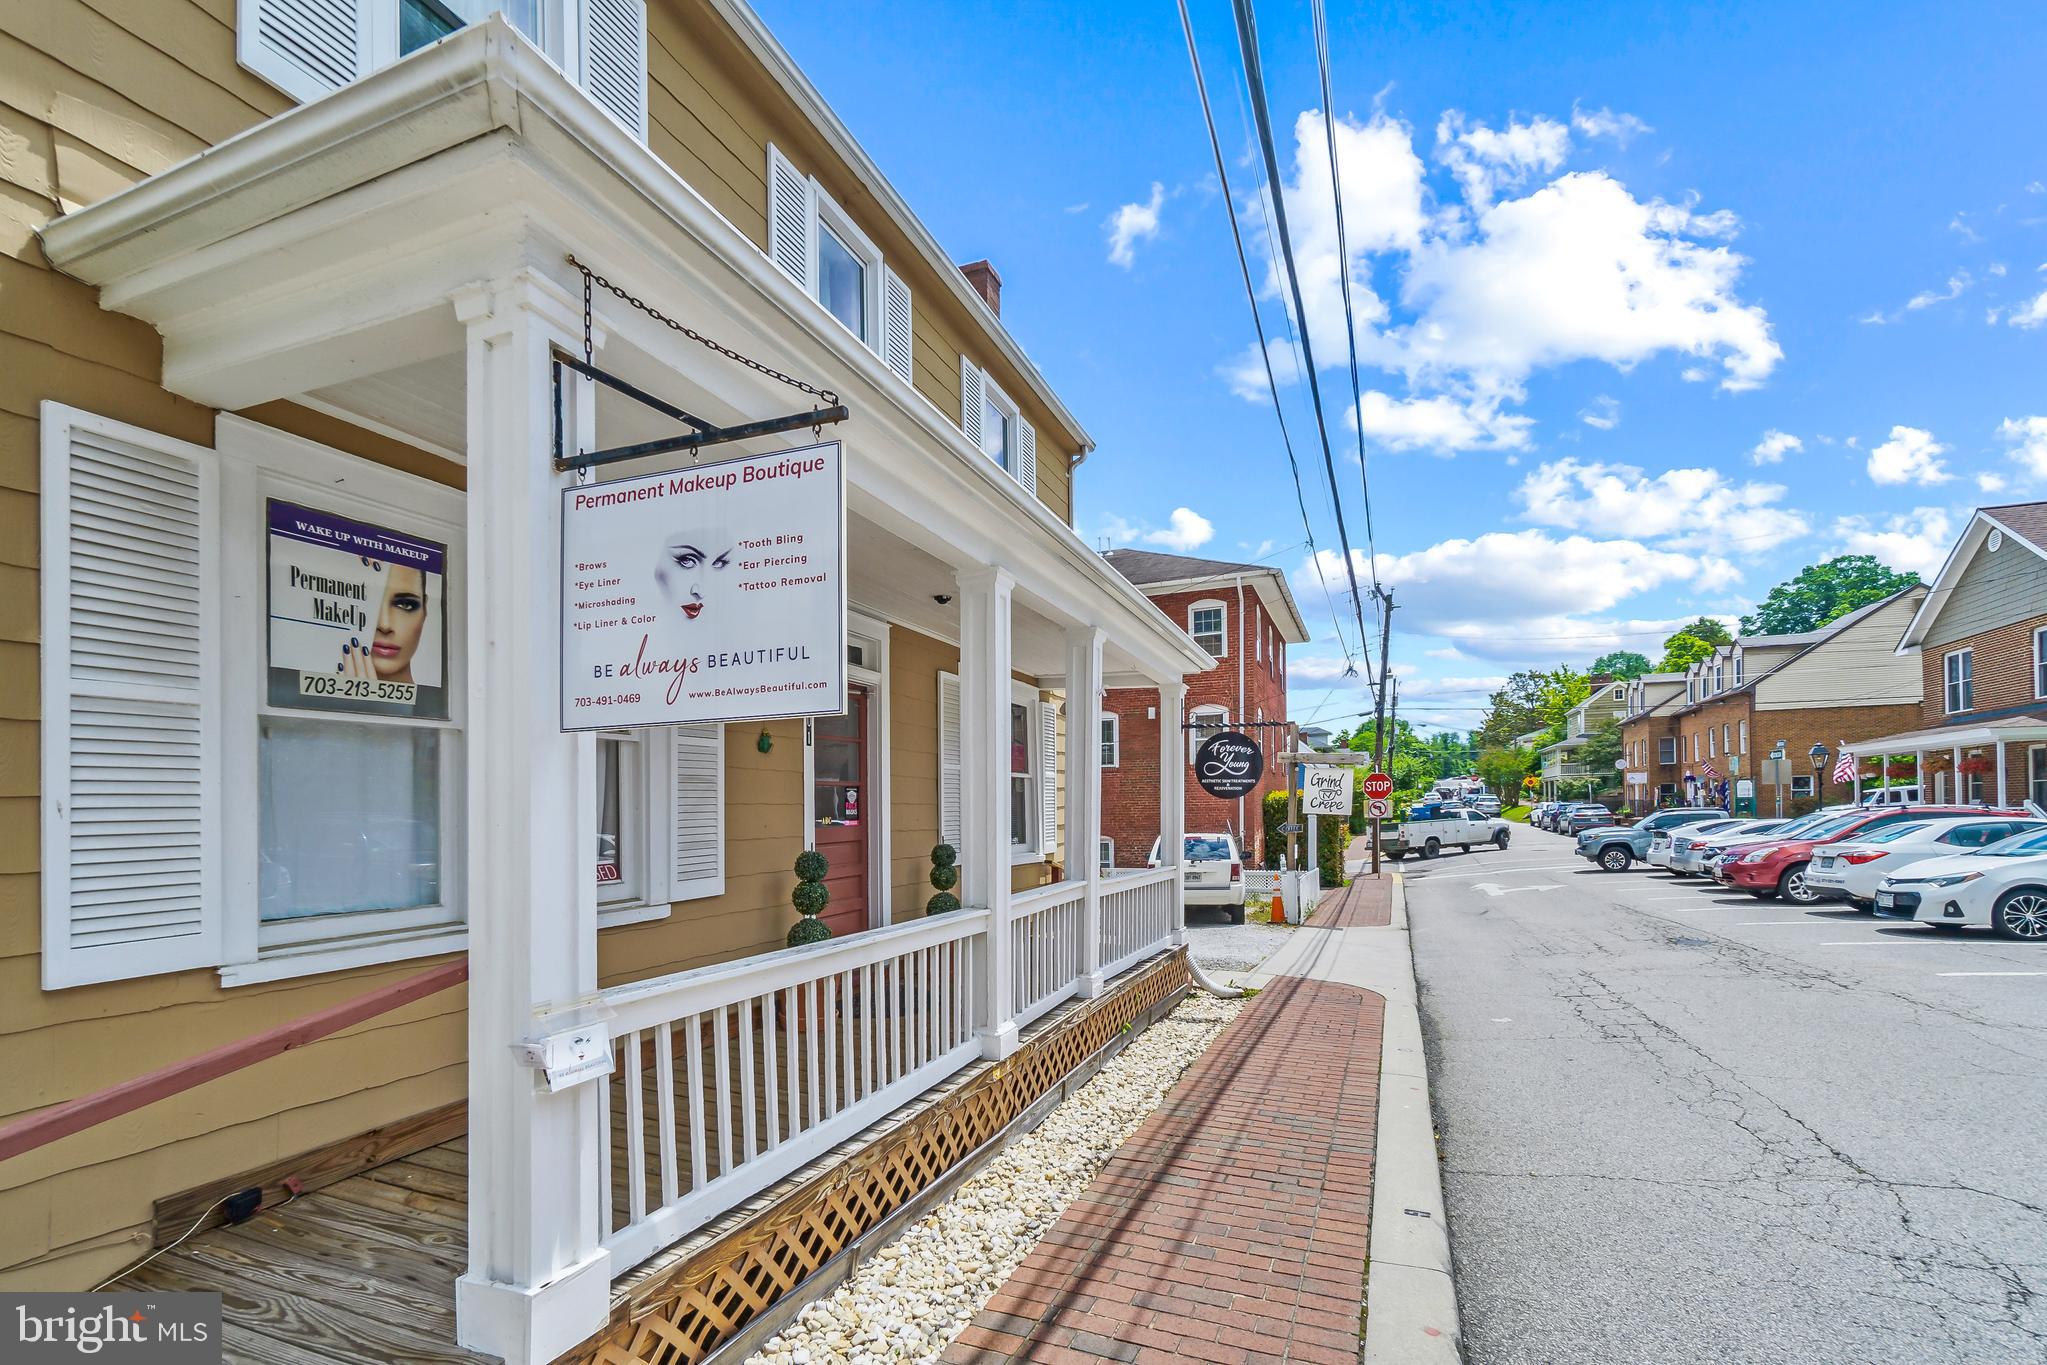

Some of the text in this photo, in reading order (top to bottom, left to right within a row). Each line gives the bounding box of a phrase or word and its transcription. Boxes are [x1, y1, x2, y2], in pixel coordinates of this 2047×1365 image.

[575, 457, 825, 510] Permanent Makeup Boutique
[296, 521, 429, 561] WAKE UP WITH MAKEUP
[776, 534, 804, 546] Bling
[765, 554, 808, 567] Piercing
[290, 565, 367, 601] Permanent
[597, 578, 622, 588] Liner
[780, 572, 827, 587] Removal
[313, 598, 367, 631] MakeUp
[595, 619, 619, 629] Liner
[621, 616, 628, 626] &
[631, 614, 657, 625] Color
[594, 634, 811, 706] BE always BEAUTIFUL
[304, 676, 415, 701] 703-213-5255
[689, 681, 828, 699] www.BeAlwaysBeautiful.com
[574, 693, 641, 708] 703-491-0469
[1208, 740, 1254, 756] Forever
[1310, 773, 1344, 789] Grind
[1366, 781, 1391, 792] STOP
[1310, 797, 1344, 812] Crepe
